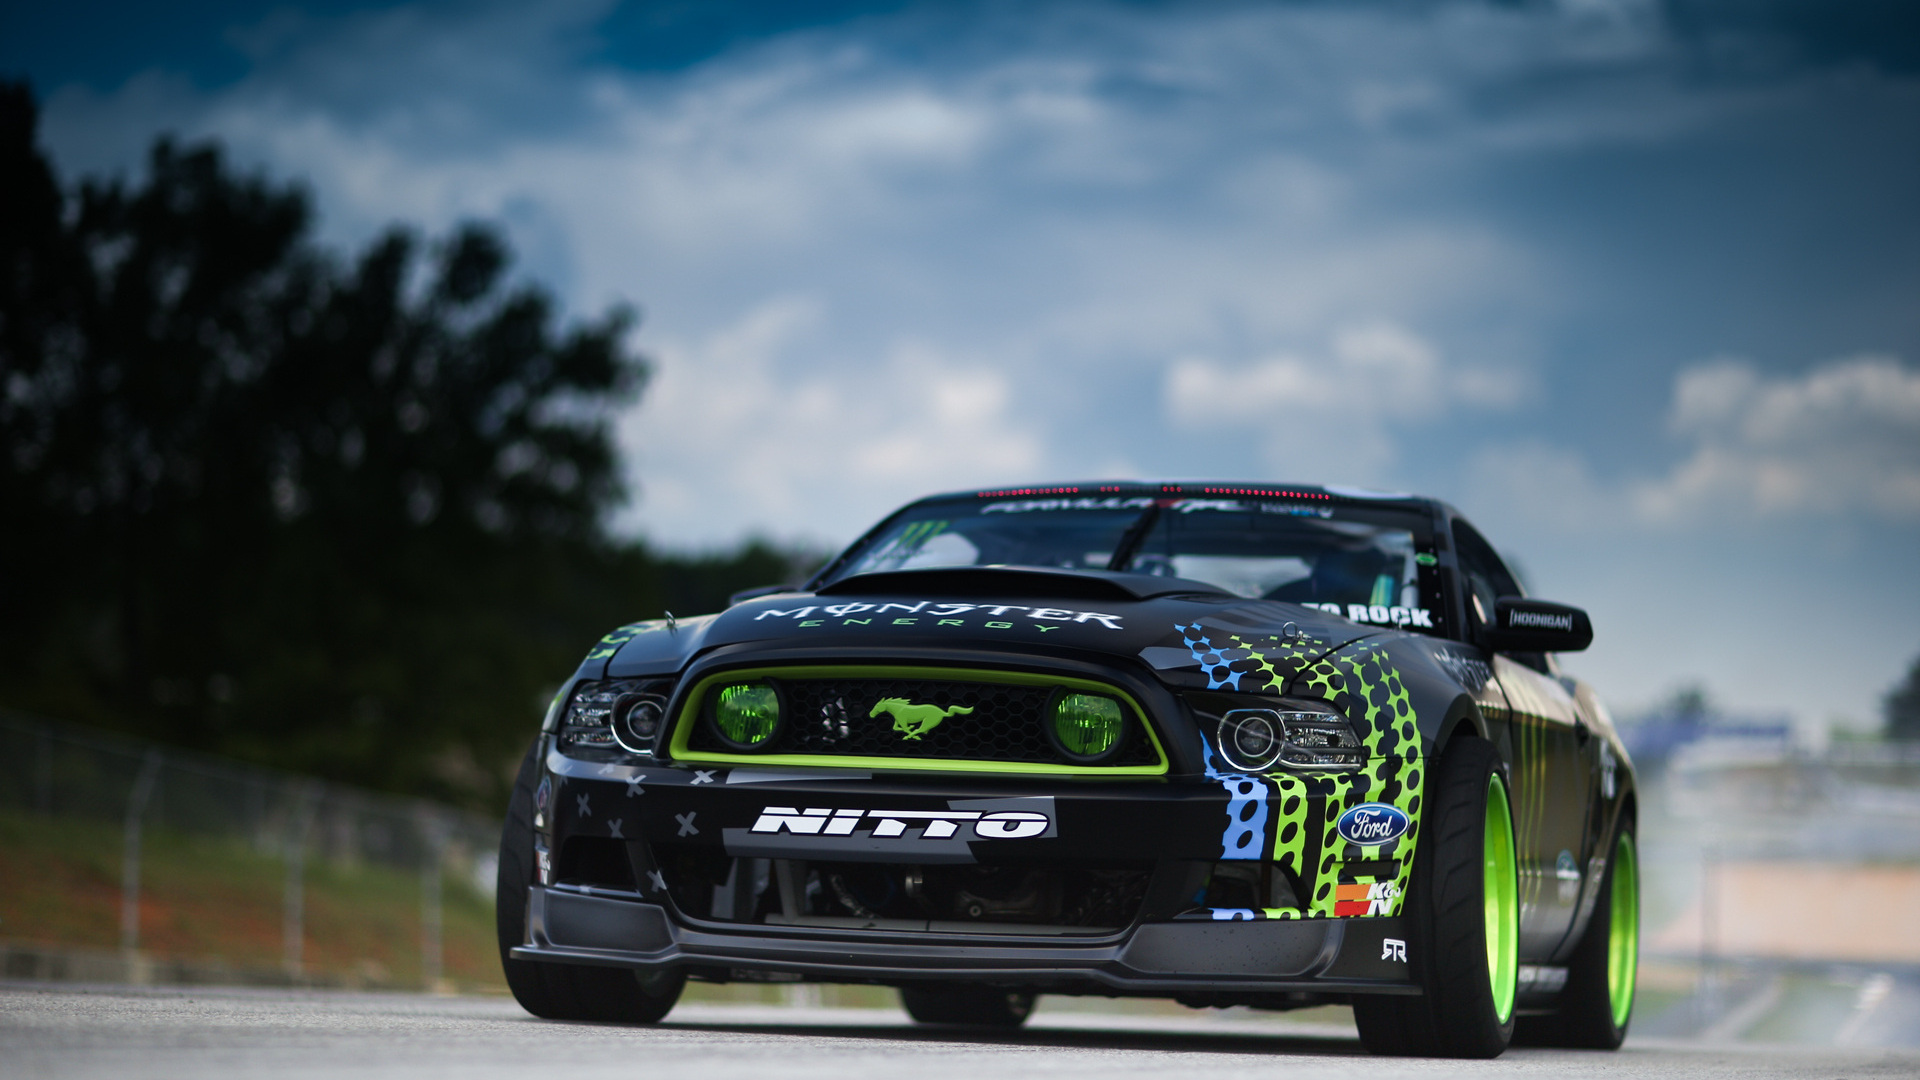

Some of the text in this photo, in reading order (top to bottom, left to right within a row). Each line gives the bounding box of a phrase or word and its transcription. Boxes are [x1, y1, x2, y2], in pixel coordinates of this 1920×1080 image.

[798, 618, 1061, 633] ENERGY
[1347, 604, 1434, 628] ROCK
[750, 806, 1049, 839] NITTO
[1350, 809, 1393, 839] Ford
